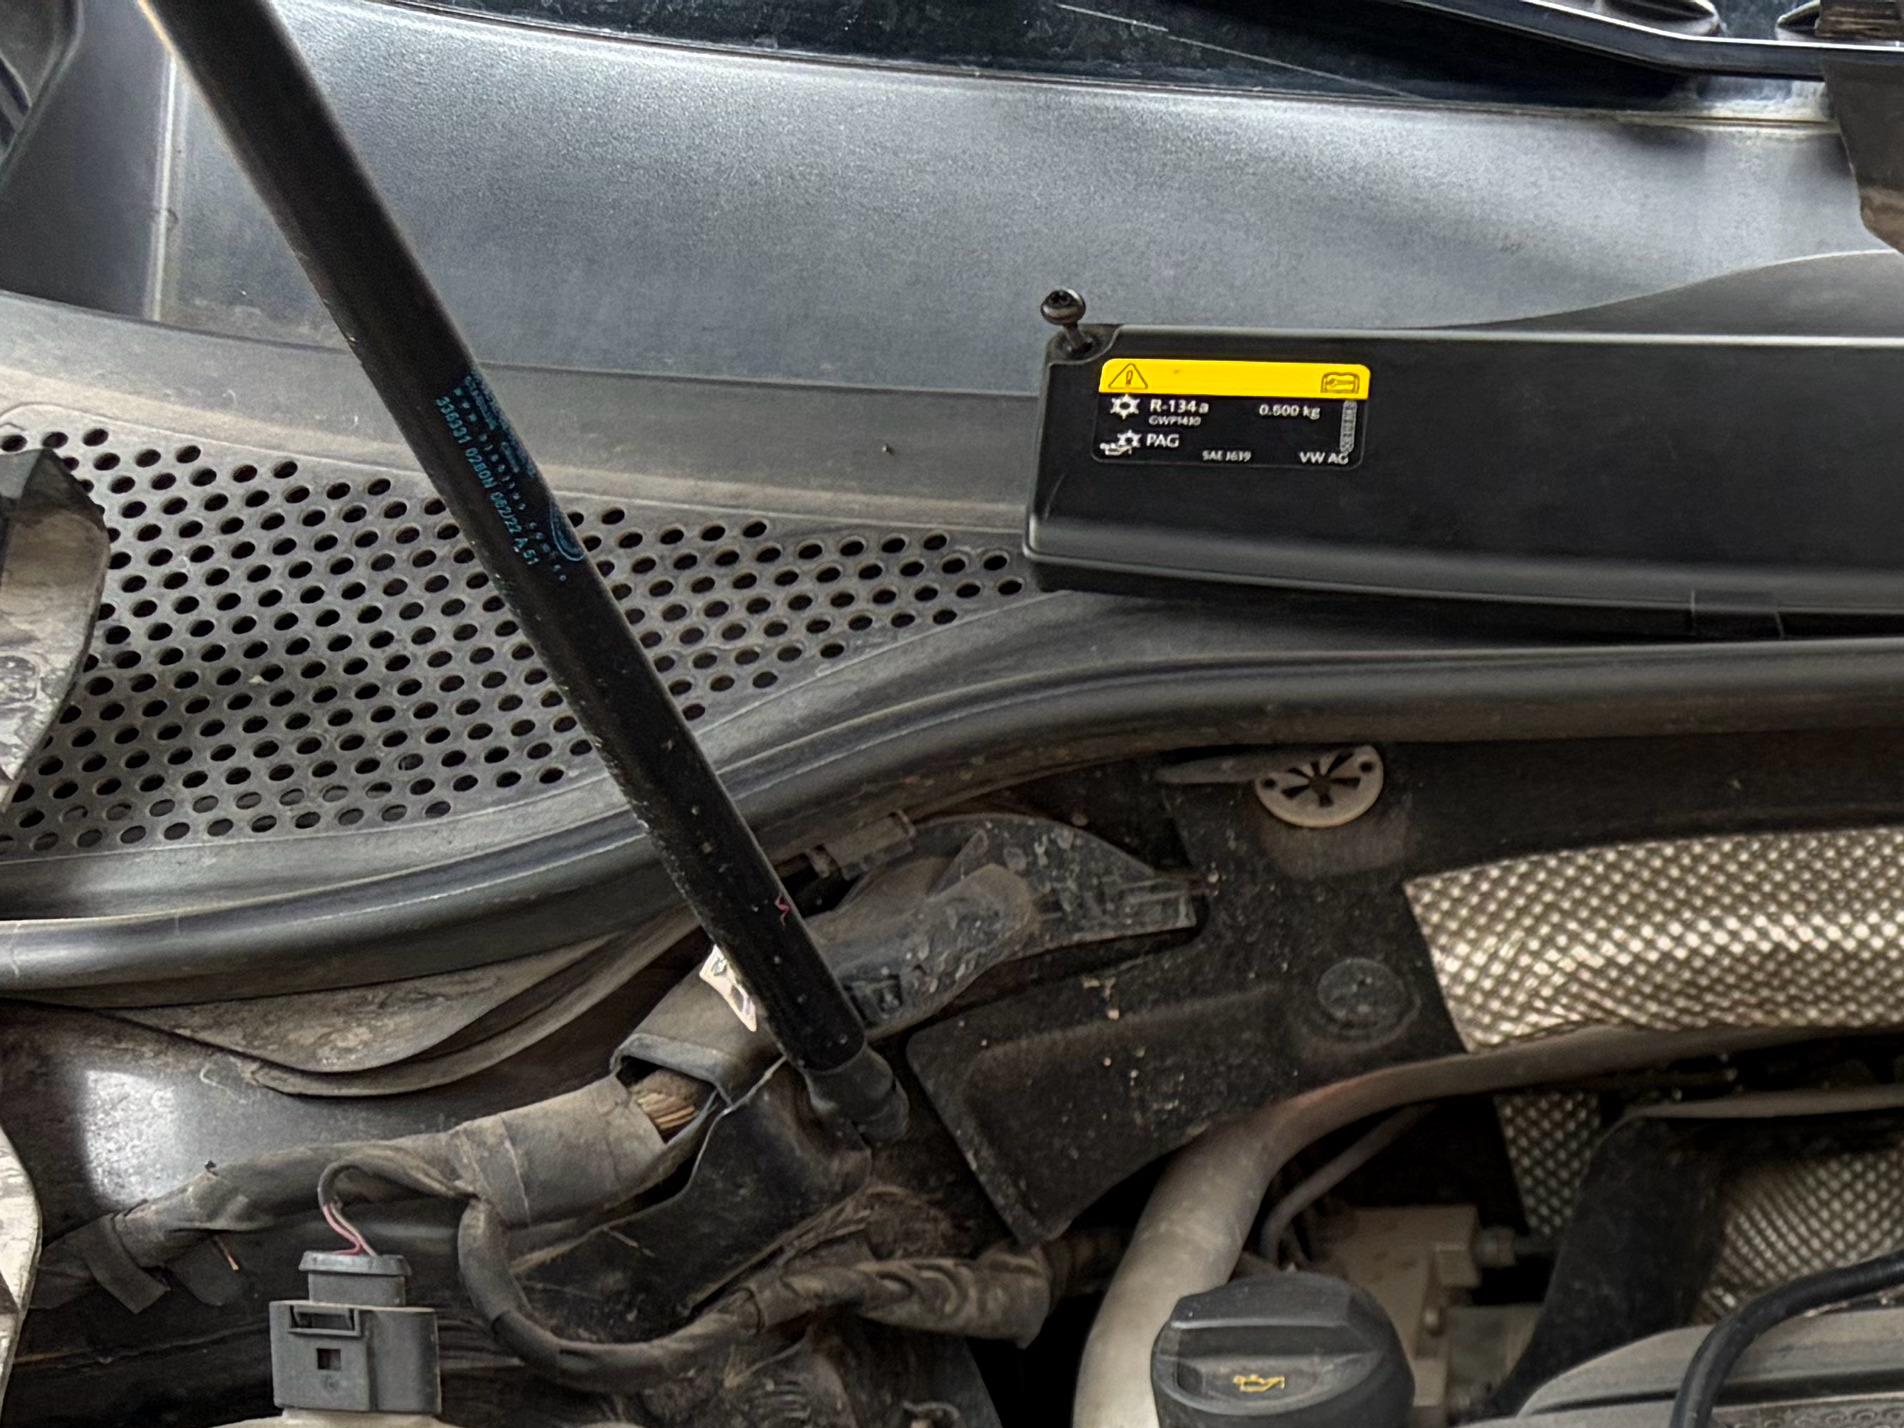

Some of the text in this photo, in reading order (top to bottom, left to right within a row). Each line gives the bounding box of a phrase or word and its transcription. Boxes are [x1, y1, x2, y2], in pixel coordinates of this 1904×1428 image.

[1302, 405, 1321, 419] kg
[1146, 433, 1180, 448] PAG
[1202, 450, 1222, 461] SAE
[1299, 451, 1349, 464] VW AG
